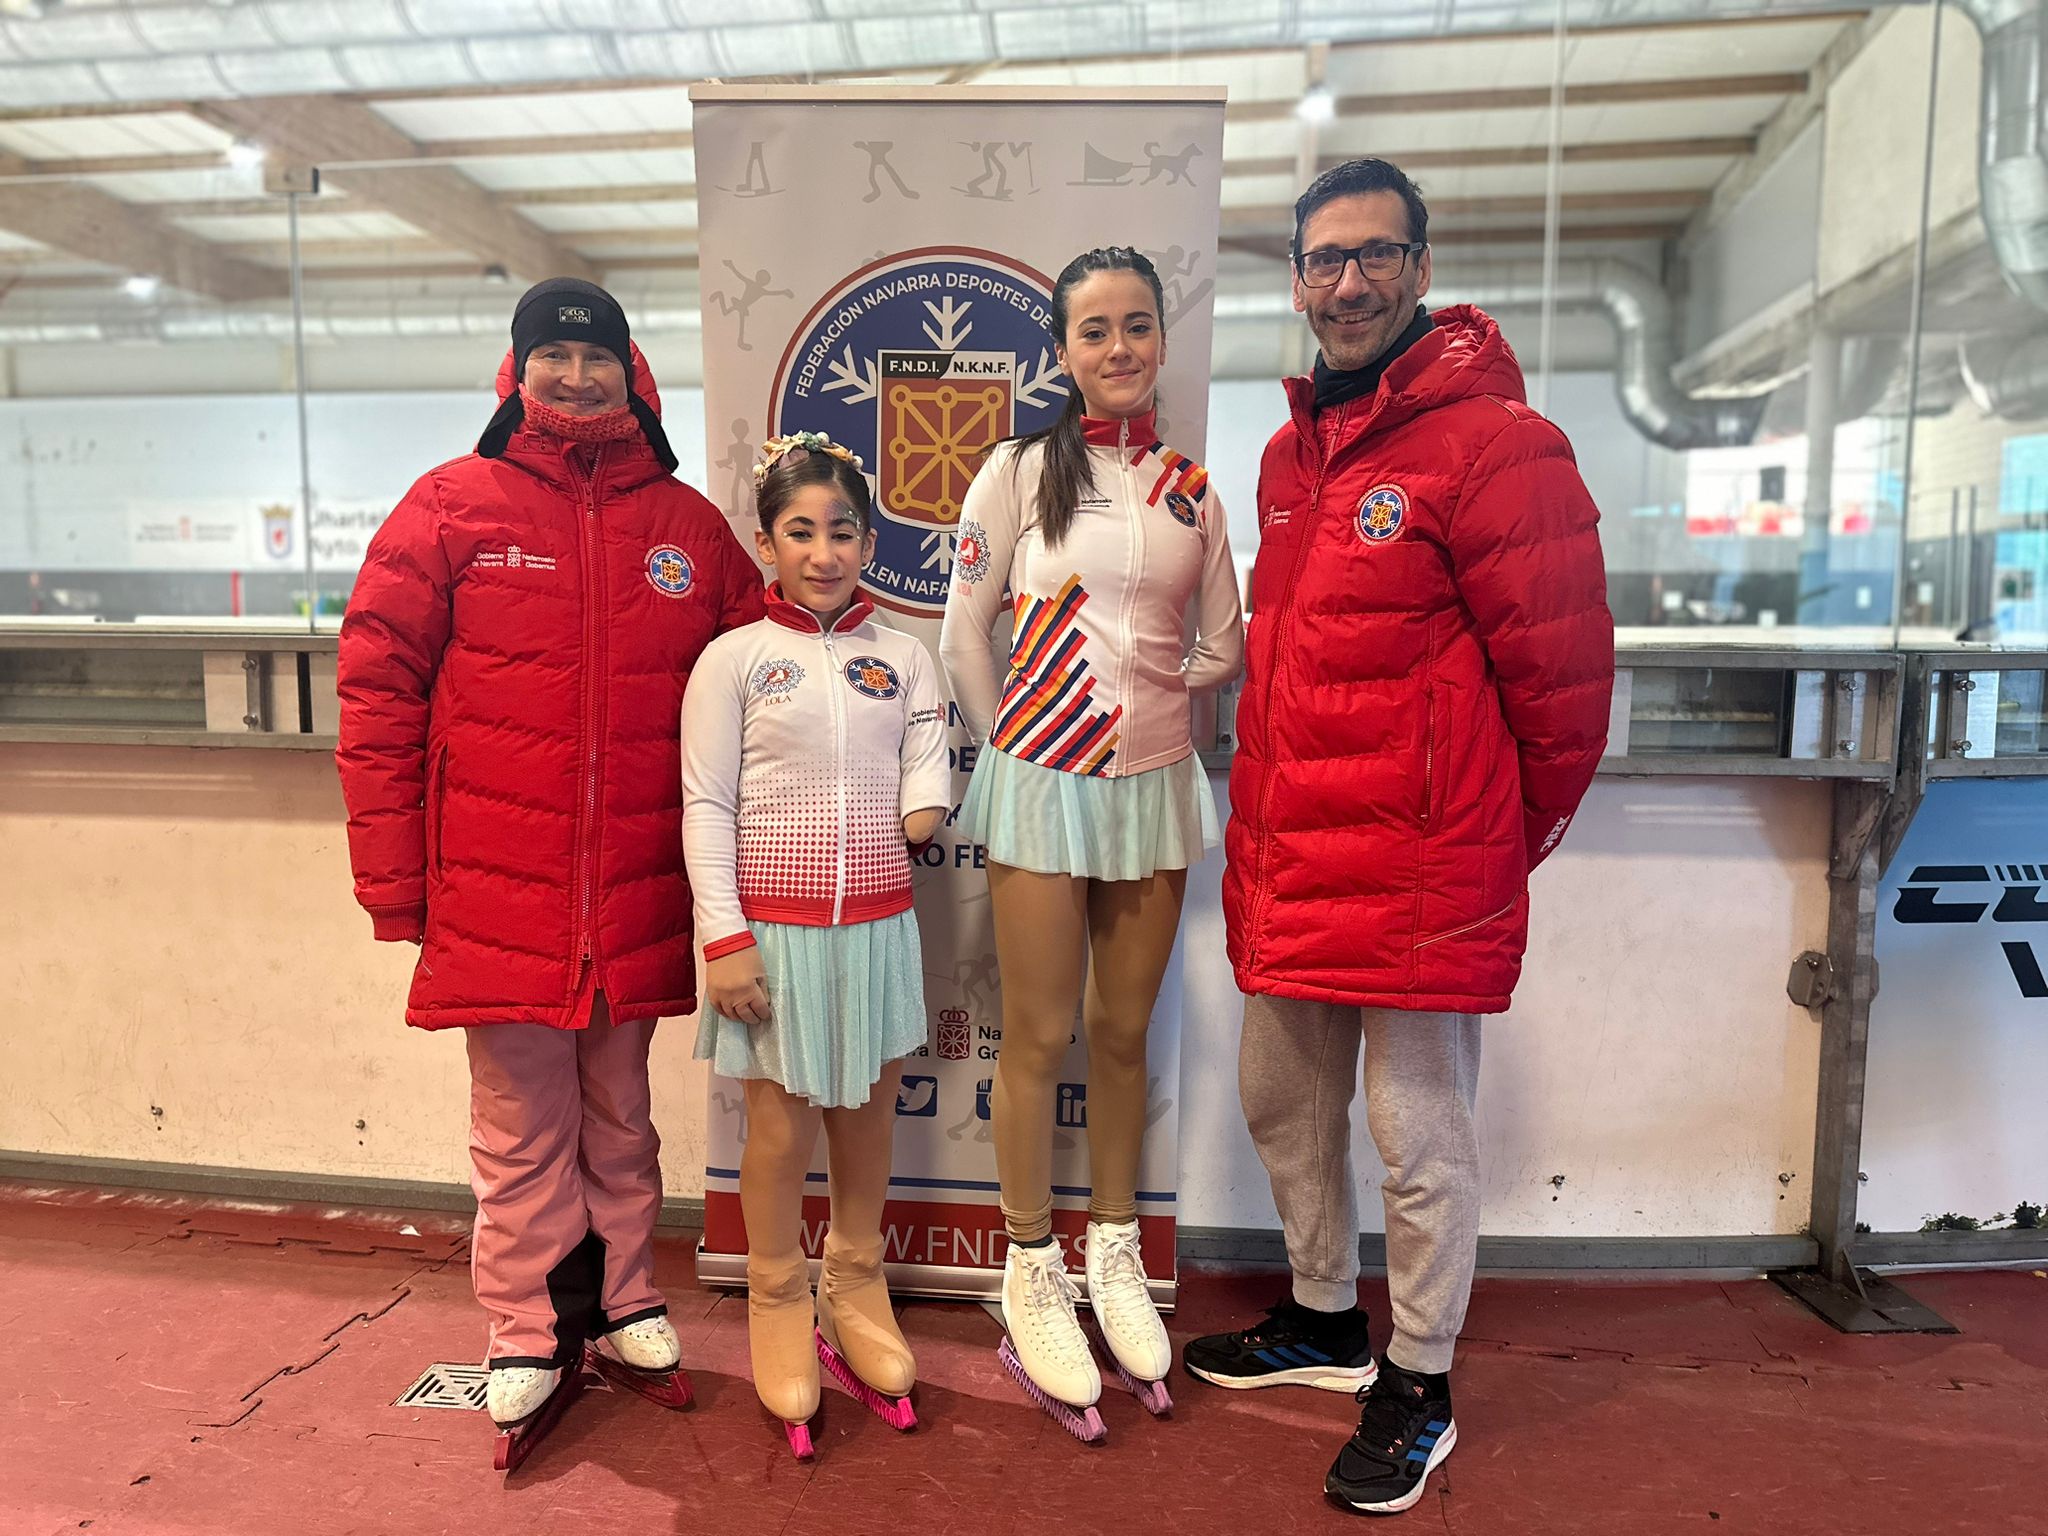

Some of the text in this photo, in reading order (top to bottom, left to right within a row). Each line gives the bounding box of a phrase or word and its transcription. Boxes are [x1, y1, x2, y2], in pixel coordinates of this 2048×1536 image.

[795, 272, 1053, 398] FEDERACIÓN NAVARRA DEPORTES DE
[889, 360, 940, 372] F.N.D.I.
[953, 361, 1010, 374] N.K.N.F.
[764, 695, 792, 706] LOLA
